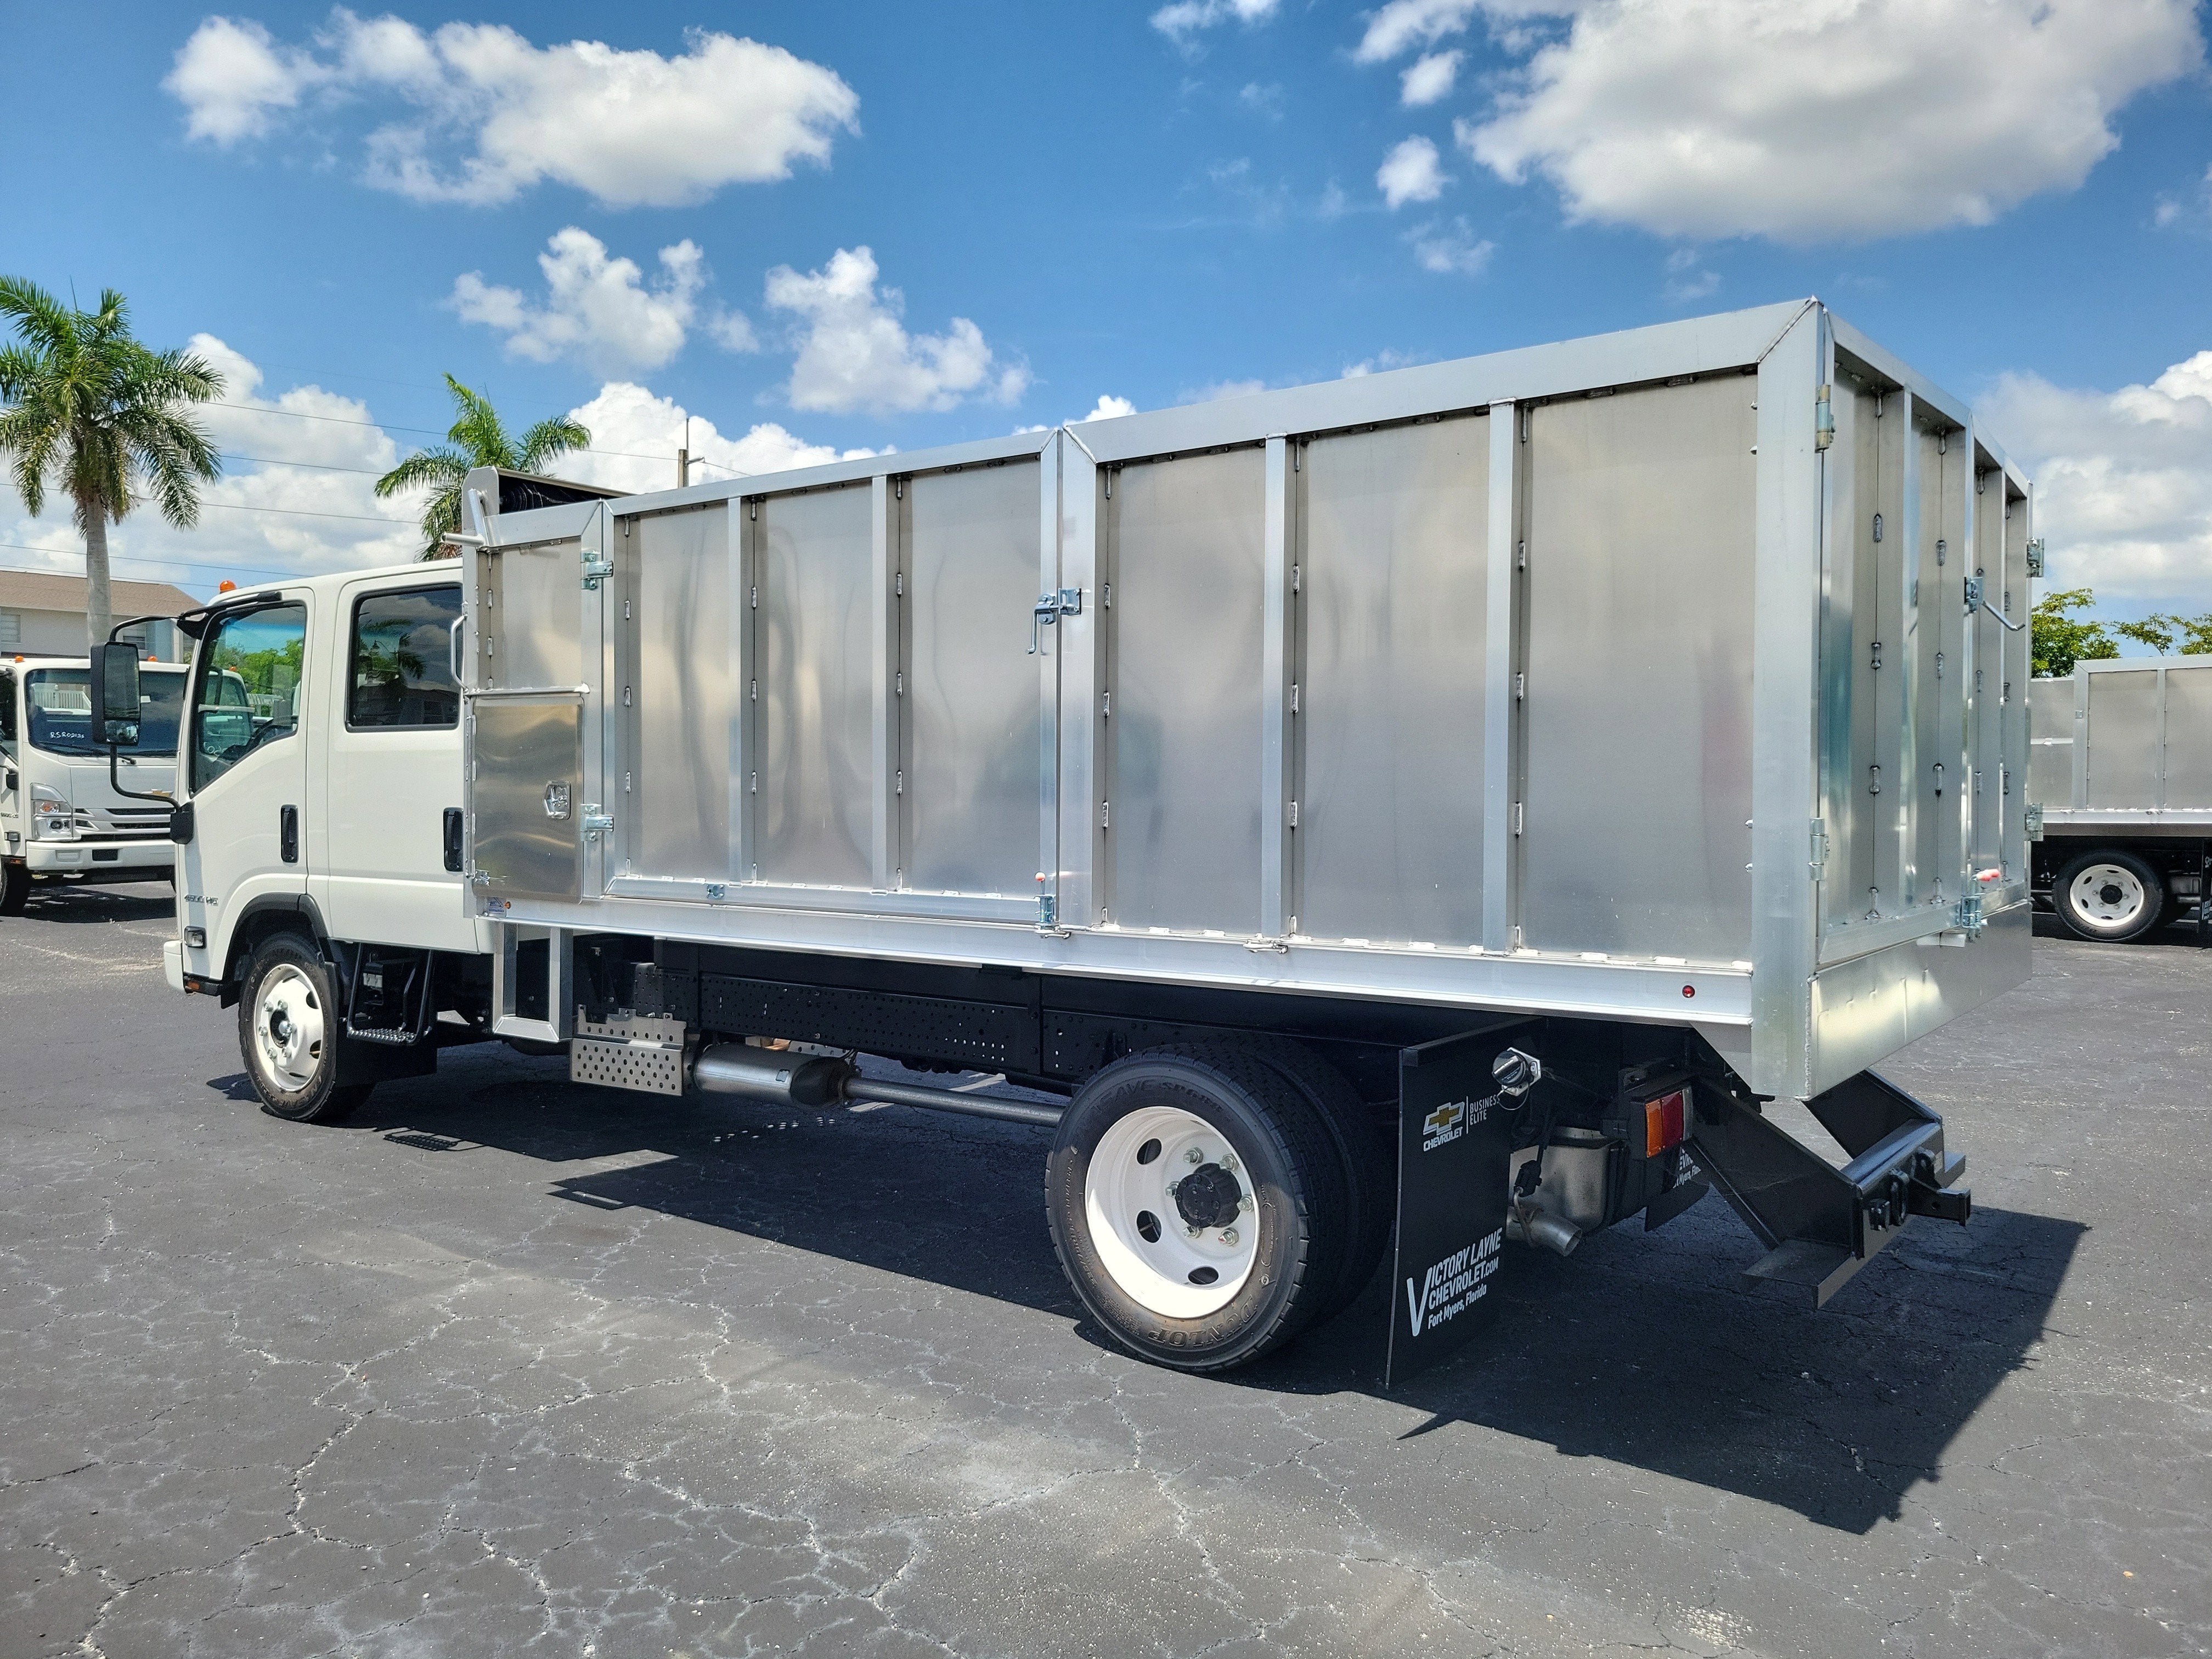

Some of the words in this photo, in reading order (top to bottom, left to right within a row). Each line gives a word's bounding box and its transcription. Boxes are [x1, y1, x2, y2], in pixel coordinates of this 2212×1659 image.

[1423, 1126, 1463, 1152] CHEVROLET
[1470, 1109, 1487, 1125] ELITE
[1406, 1246, 1470, 1336] VICTORY
[1470, 1227, 1503, 1265] LAYNE
[1428, 1256, 1499, 1310] CHEVROLET.COM
[1427, 1310, 1443, 1329] Fort
[1443, 1299, 1465, 1321] Myers,
[1465, 1283, 1487, 1306] Florida
